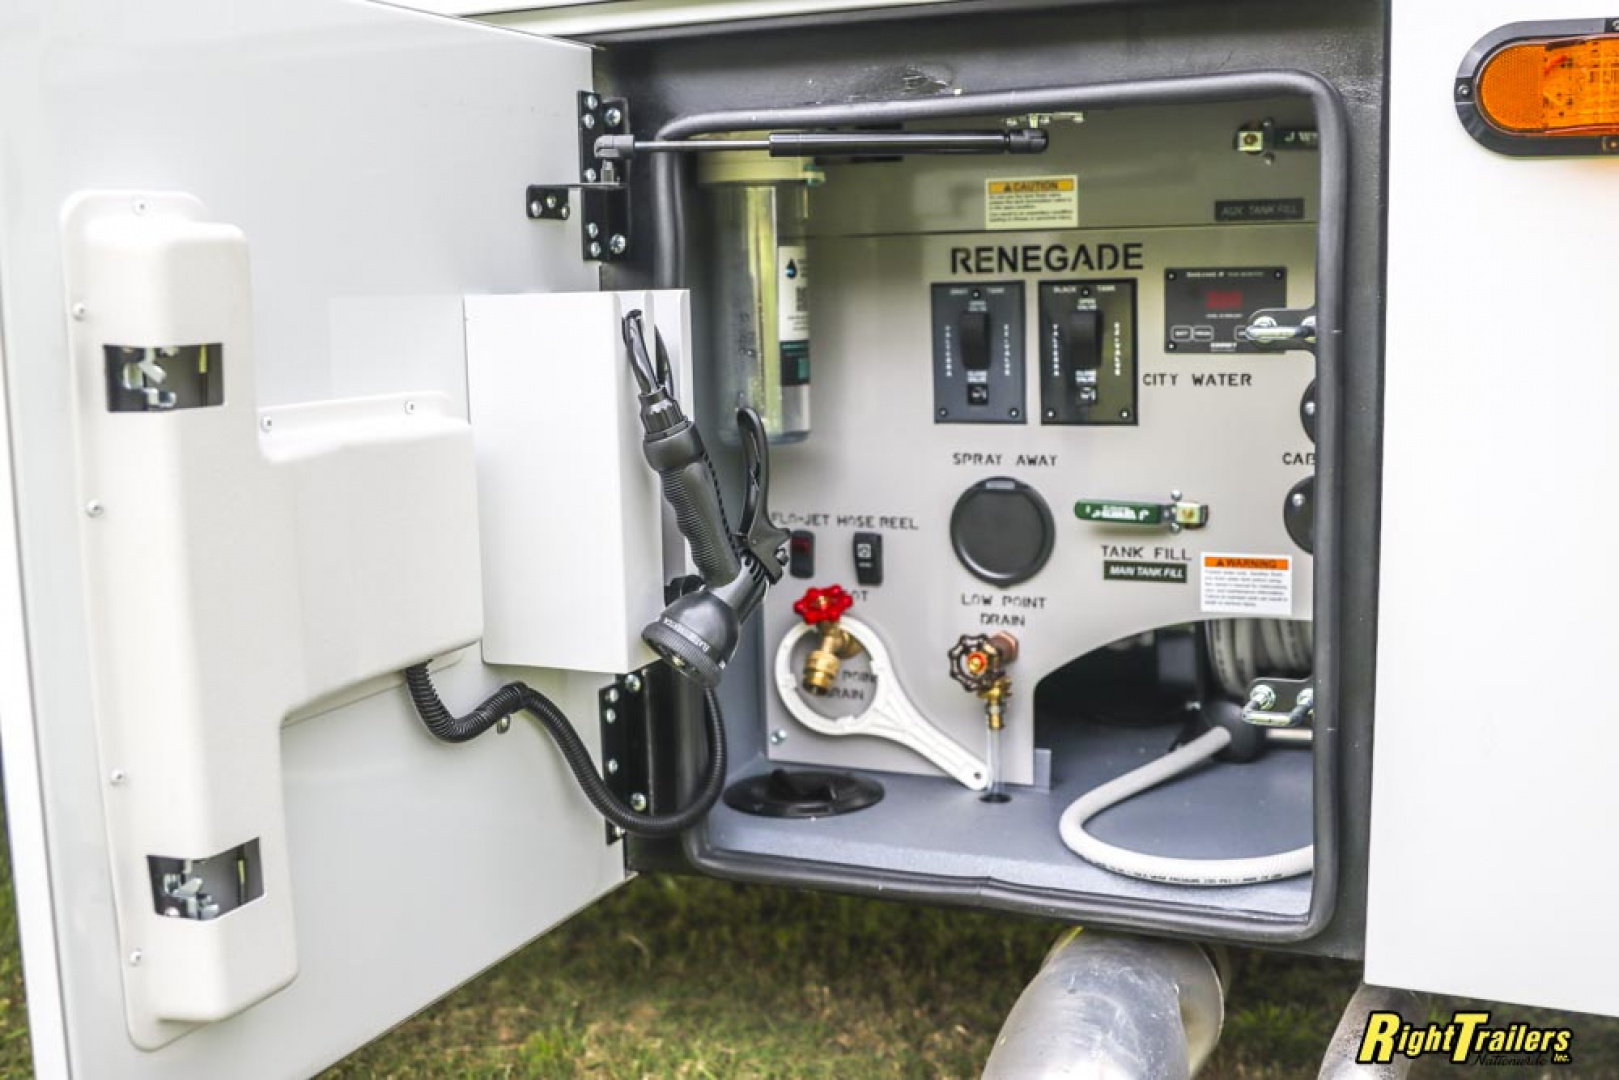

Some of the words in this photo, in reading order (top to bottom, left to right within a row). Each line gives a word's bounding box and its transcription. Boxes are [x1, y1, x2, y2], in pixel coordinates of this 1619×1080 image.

[1012, 181, 1059, 192] CAUTION
[950, 242, 1144, 275] RENEGADE
[1142, 373, 1179, 387] CITY
[1191, 373, 1252, 387] WATER
[952, 452, 1002, 466] SPRAY
[1015, 453, 1059, 467] AWAY
[836, 514, 875, 529] HOSE
[879, 516, 919, 531] REEL
[1101, 544, 1144, 558] TANK
[1153, 546, 1192, 561] FILL
[1225, 558, 1277, 569] WARNING
[1109, 565, 1135, 576] MAIN
[1136, 566, 1162, 578] TANK
[1163, 567, 1184, 579] FILL
[961, 593, 993, 606] LOW
[1002, 595, 1047, 609] POINT
[980, 612, 1026, 627] DRAIN
